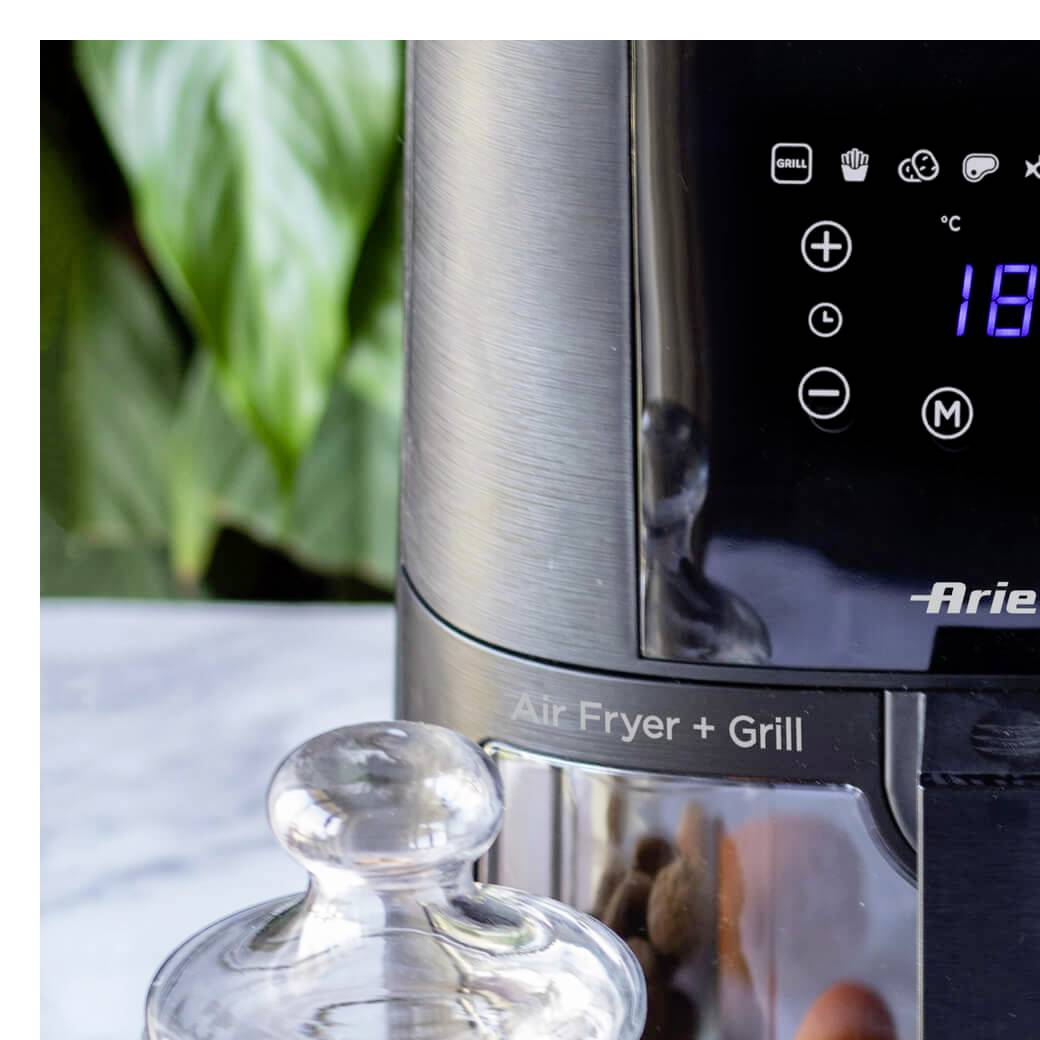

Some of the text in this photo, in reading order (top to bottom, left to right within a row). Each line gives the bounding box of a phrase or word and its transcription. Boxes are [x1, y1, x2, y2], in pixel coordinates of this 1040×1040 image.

[776, 158, 808, 170] GRILL
[933, 399, 962, 429] M
[511, 692, 803, 752] Air Fryer + Grill
